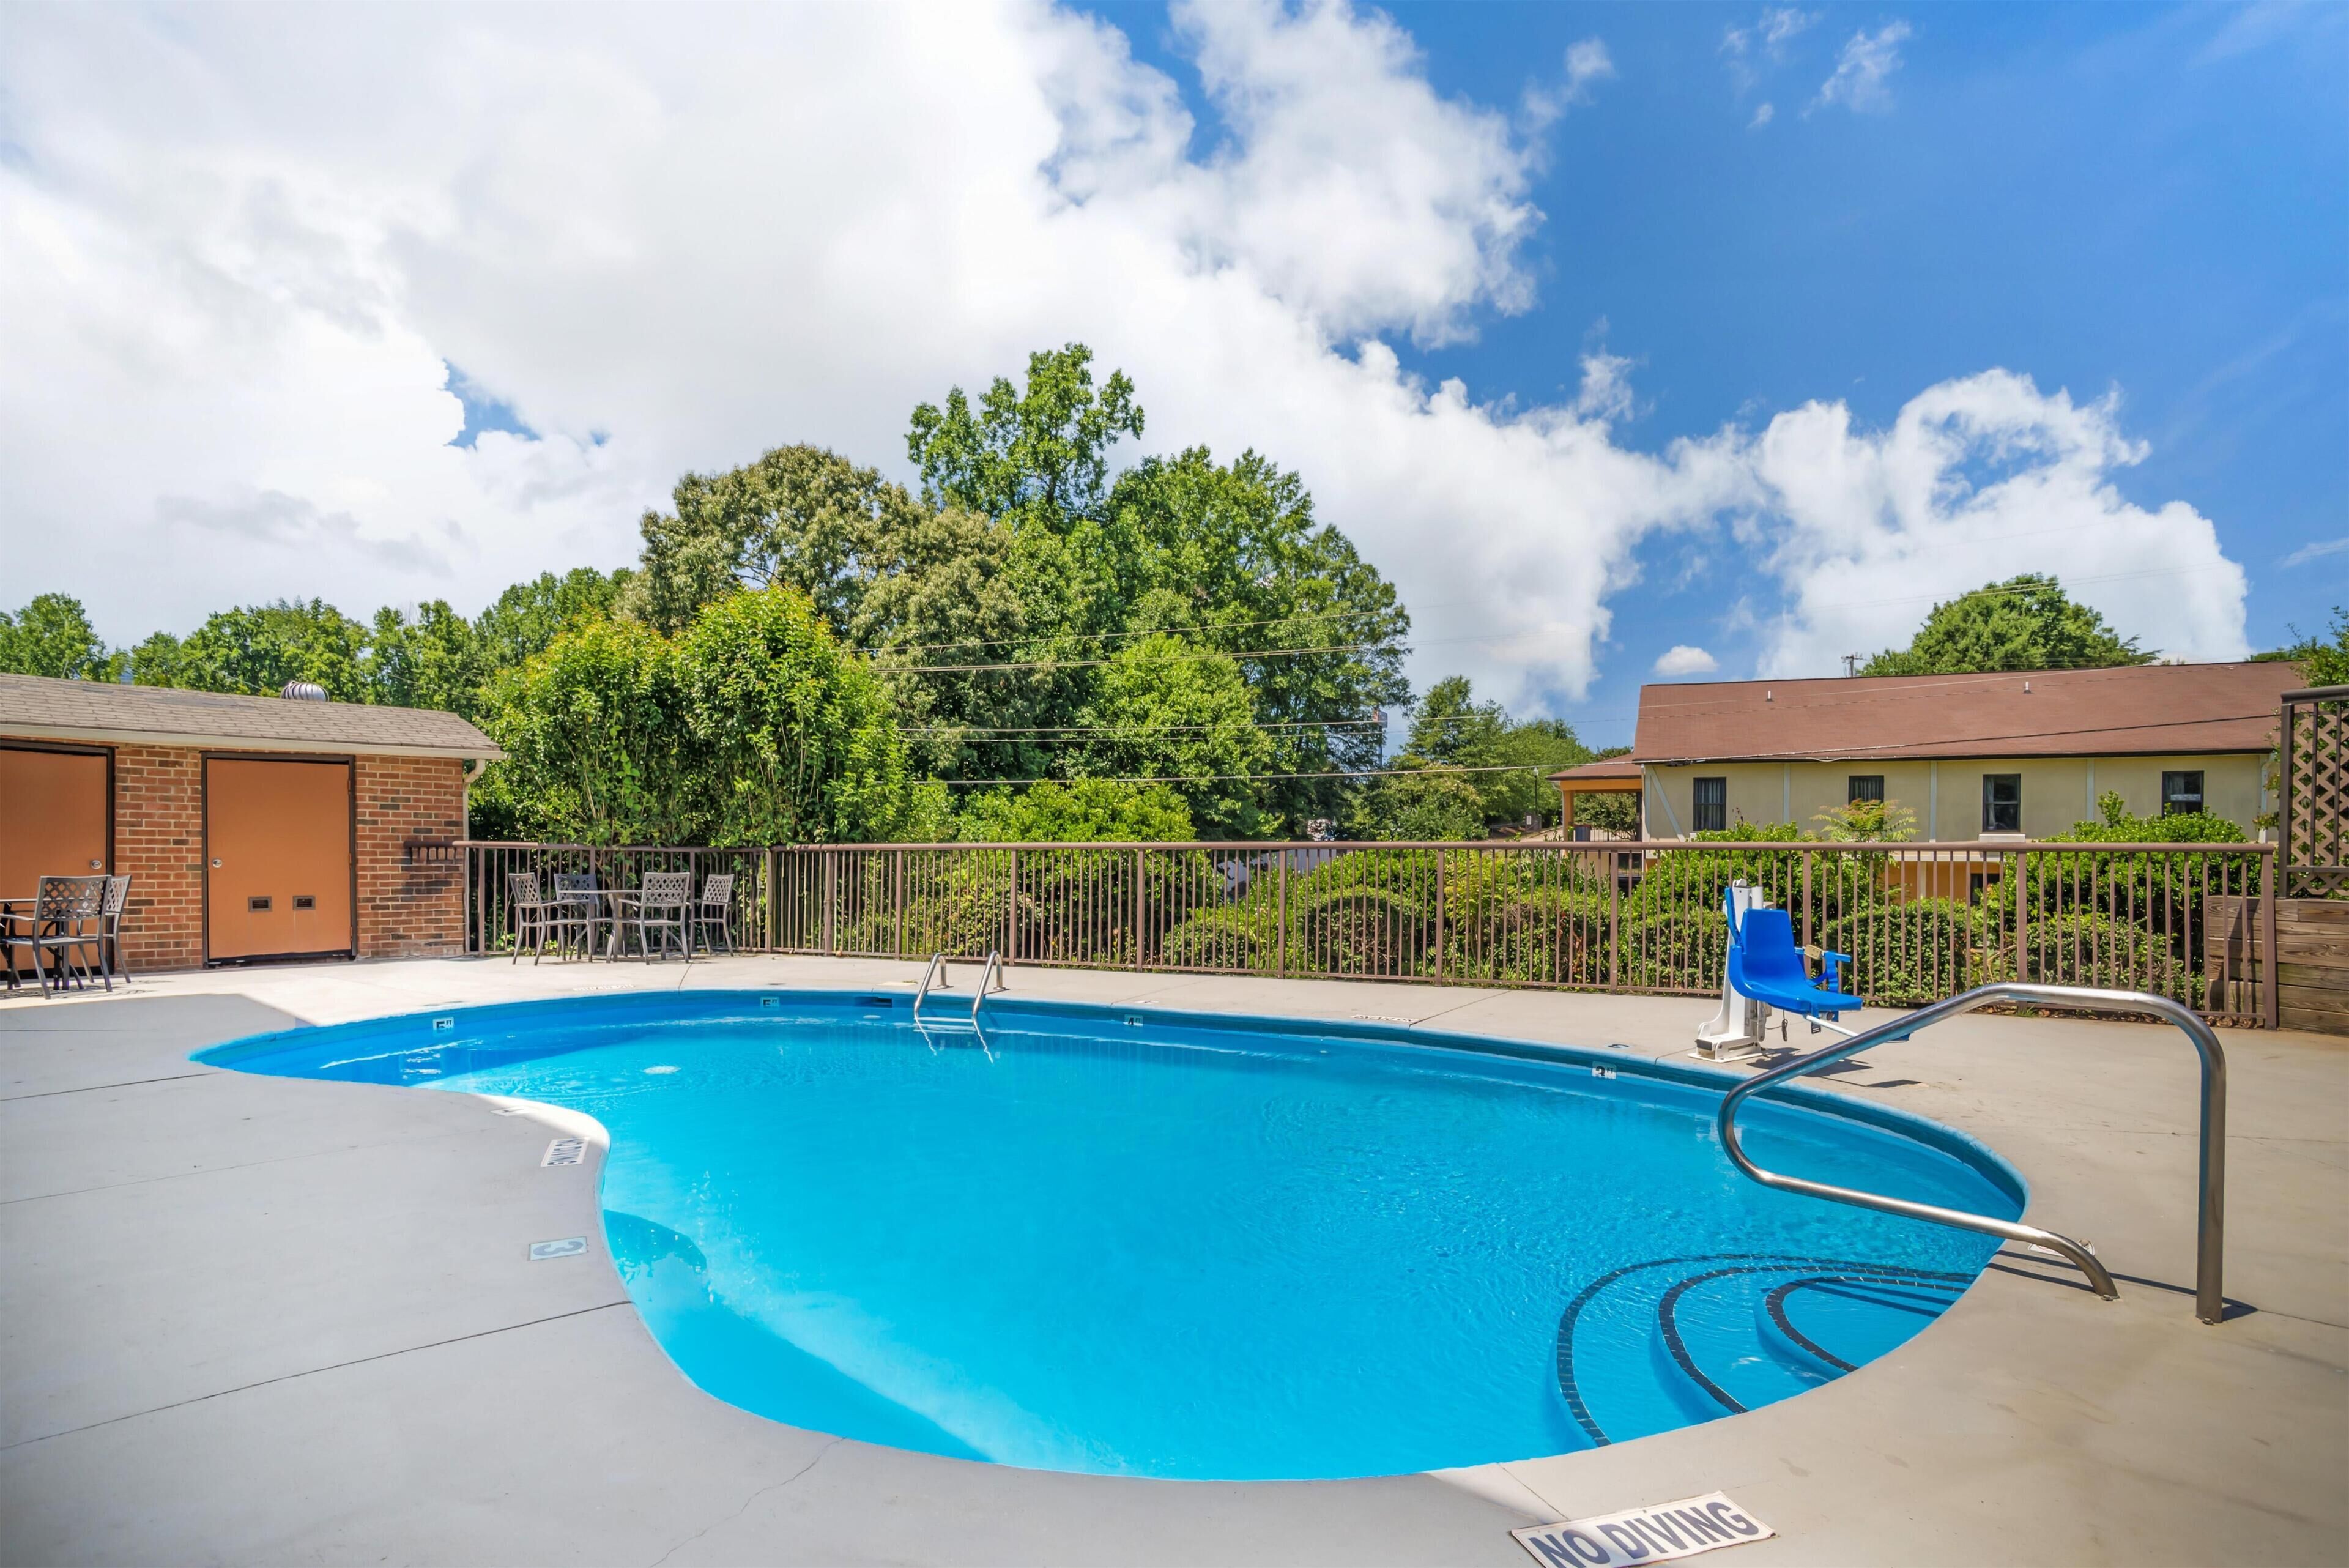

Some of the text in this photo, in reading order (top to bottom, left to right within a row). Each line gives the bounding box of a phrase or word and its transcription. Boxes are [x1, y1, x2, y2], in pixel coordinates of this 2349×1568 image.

[533, 1241, 584, 1255] 3
[1529, 1501, 1759, 1568] NO DIVING
